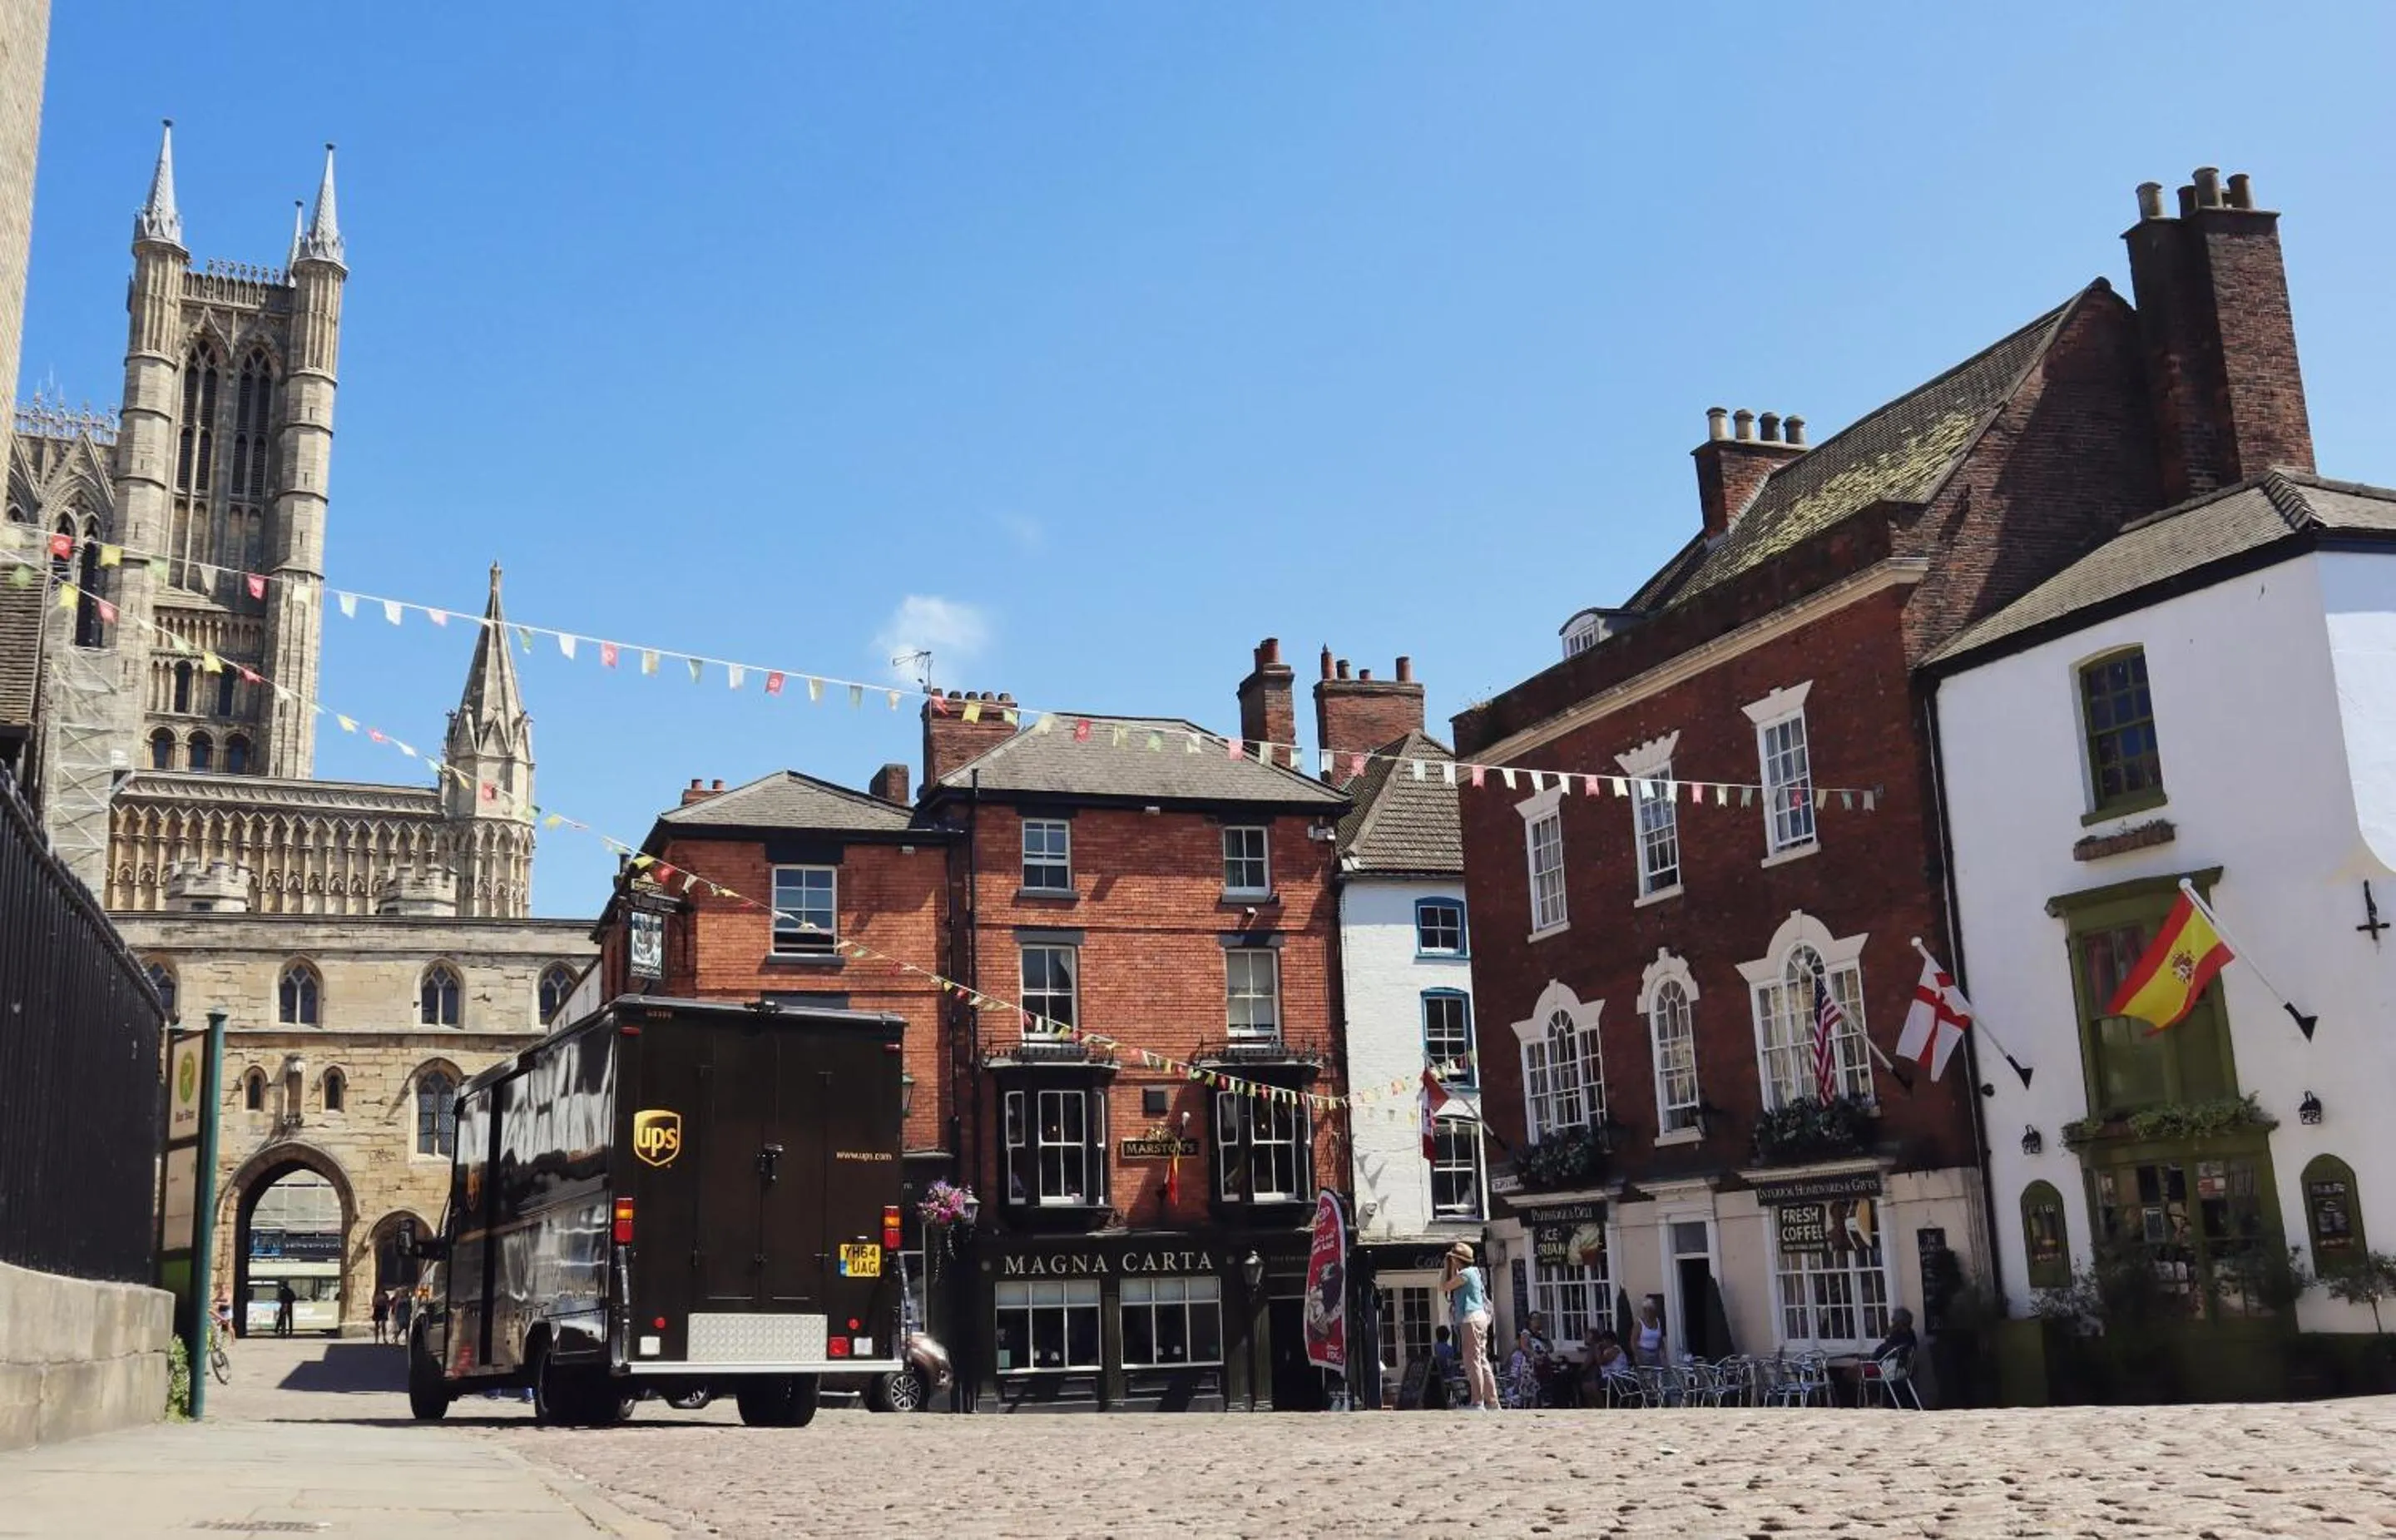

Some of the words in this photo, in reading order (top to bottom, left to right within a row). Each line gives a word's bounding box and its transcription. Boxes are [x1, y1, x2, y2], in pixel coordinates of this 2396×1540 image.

[638, 1127, 676, 1156] ups
[836, 1151, 892, 1161] www.ups.com
[1782, 1207, 1819, 1224] FRESH
[1543, 1228, 1558, 1241] ICE
[1782, 1225, 1824, 1242] COFFEE
[844, 1245, 876, 1259] YH64
[852, 1260, 876, 1275] UAG
[1004, 1254, 1109, 1275] MAGNA
[1122, 1251, 1213, 1272] CARTA
